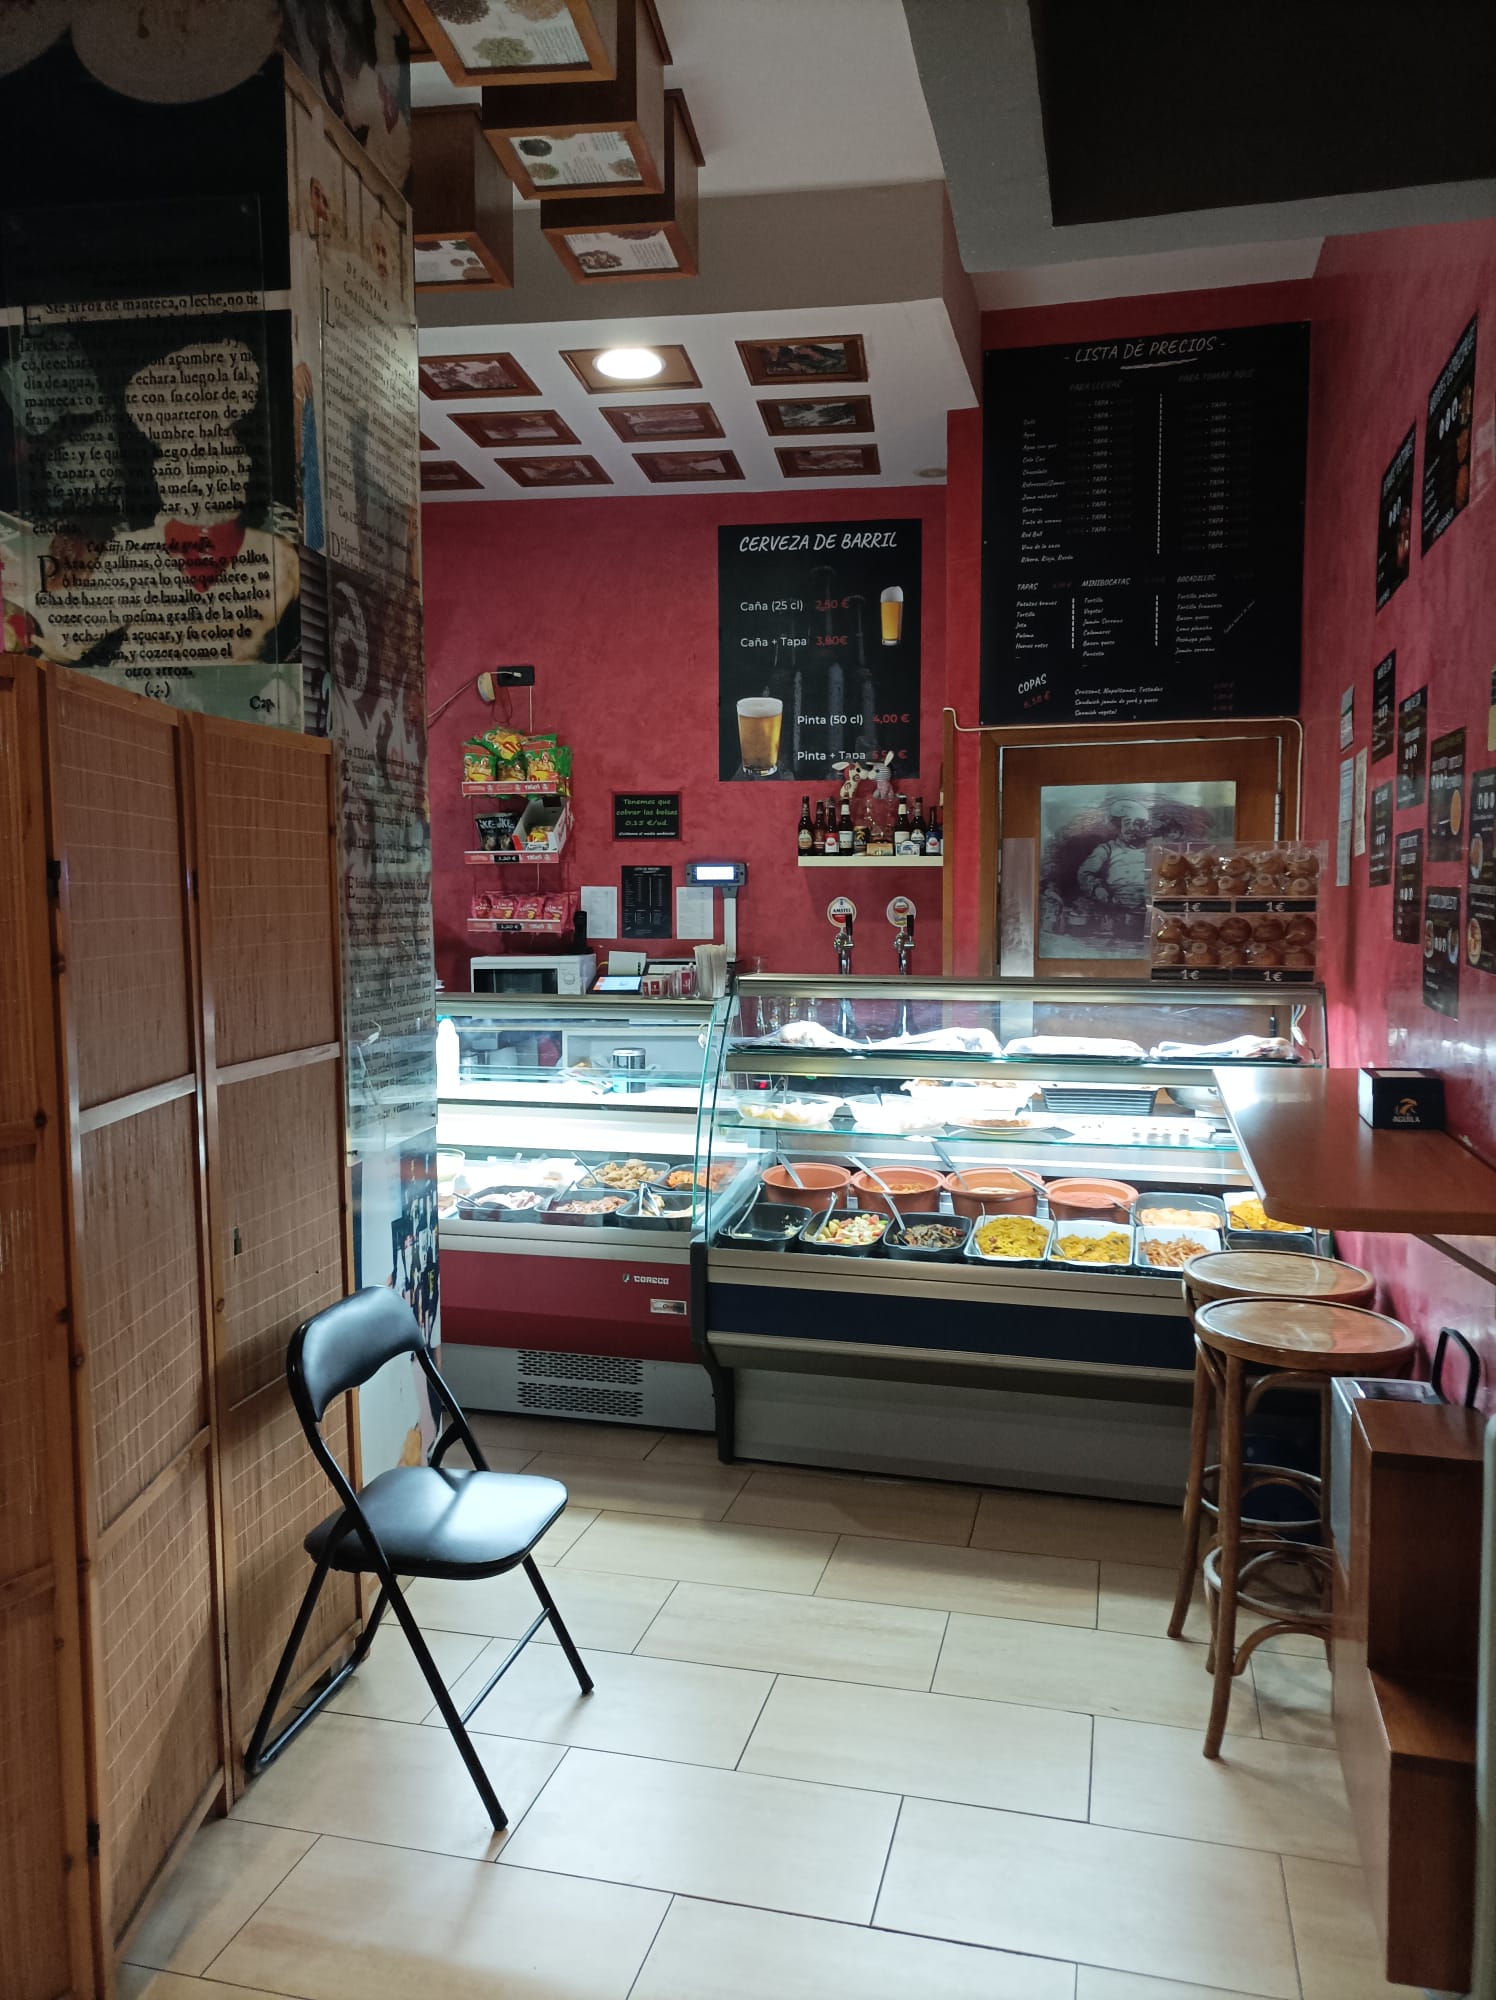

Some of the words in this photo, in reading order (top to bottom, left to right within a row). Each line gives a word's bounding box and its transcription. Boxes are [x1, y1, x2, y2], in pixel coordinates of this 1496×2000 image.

[1075, 345, 1118, 362] LISTA
[1122, 343, 1145, 360] DE
[1148, 336, 1218, 356] PRECIOS
[136, 373, 176, 386] echara
[142, 393, 165, 403] con
[184, 389, 219, 402] color
[149, 427, 194, 440] lumbre
[190, 445, 206, 457] de
[739, 535, 810, 553] CERVEZA
[813, 533, 837, 551] DE
[840, 531, 898, 550] BARRIL
[158, 571, 171, 584] lo
[1017, 582, 1039, 592] TAPAS
[740, 600, 768, 611] Caña
[771, 600, 788, 612] (25
[790, 600, 804, 612] cl)
[740, 637, 768, 648] Caña
[780, 636, 808, 649] Tapa
[1017, 673, 1048, 694] COPAS
[797, 714, 827, 726] Pinta
[829, 715, 848, 727] (50
[849, 714, 864, 726] cl)
[899, 713, 911, 724] €
[797, 751, 827, 762] Pinta
[1182, 901, 1201, 912] 1€
[1265, 901, 1286, 912] 1€
[1181, 969, 1200, 980] 1€
[1263, 970, 1284, 982] 1€
